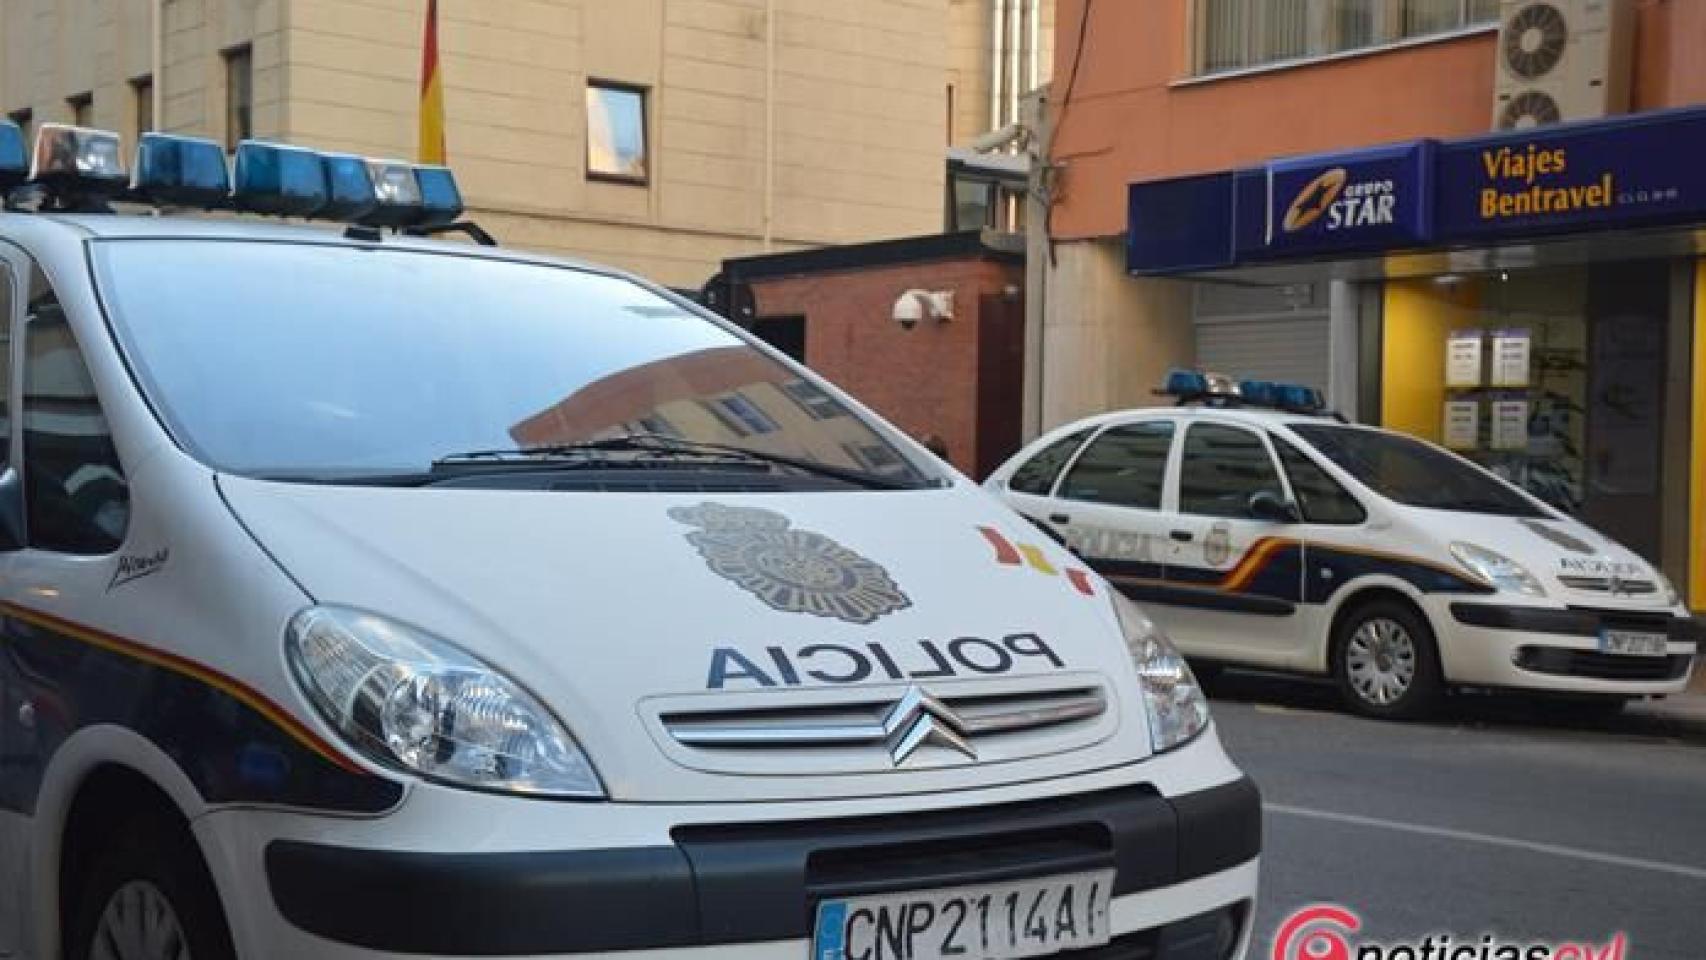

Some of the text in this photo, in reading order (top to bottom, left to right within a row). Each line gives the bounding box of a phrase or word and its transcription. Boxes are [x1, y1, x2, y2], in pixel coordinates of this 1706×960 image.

[1483, 146, 1565, 181] Viajes
[1326, 196, 1395, 231] STAR
[1482, 175, 1611, 218] Bentravel
